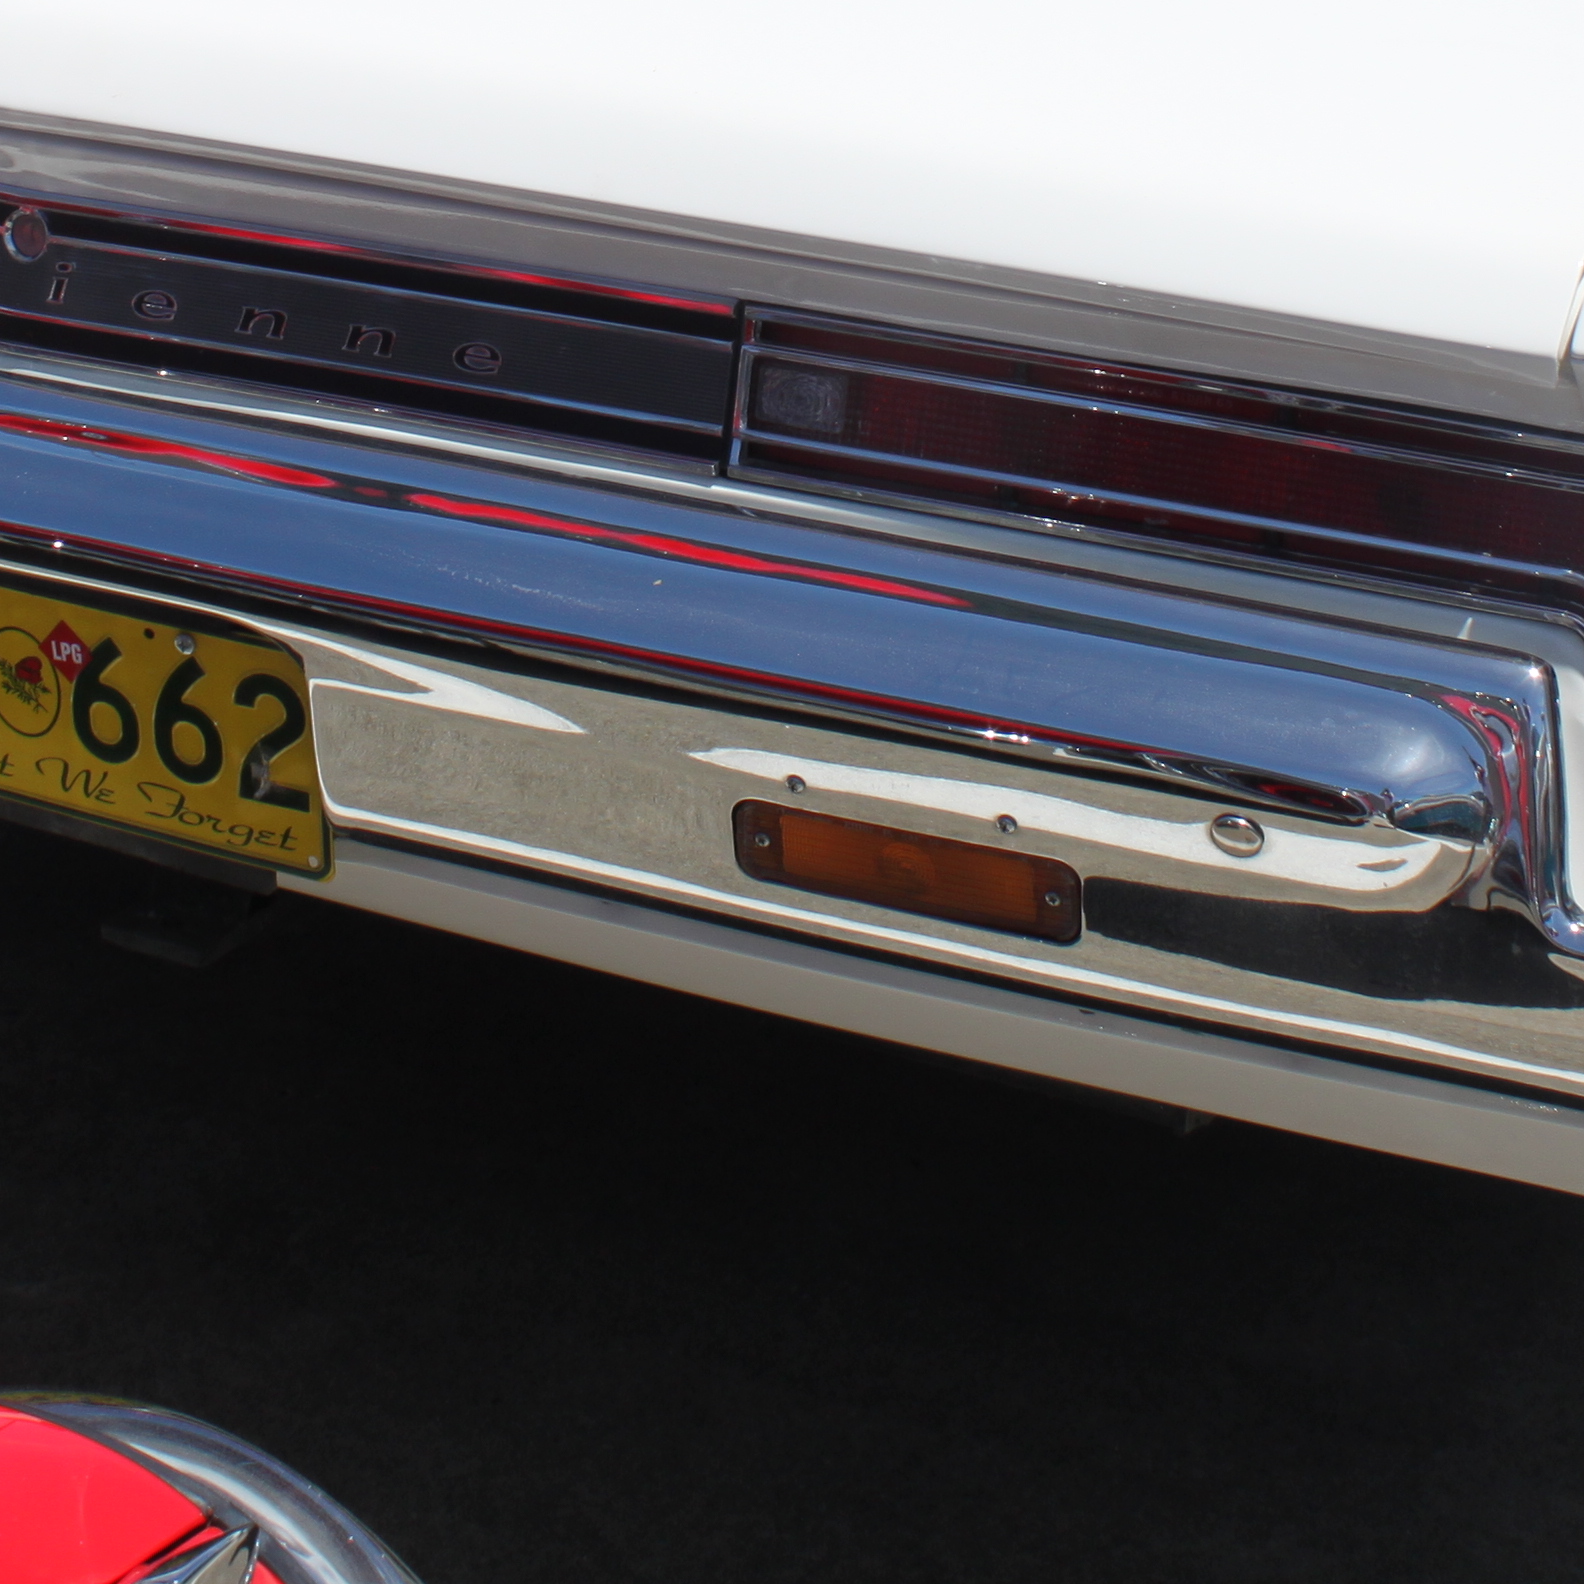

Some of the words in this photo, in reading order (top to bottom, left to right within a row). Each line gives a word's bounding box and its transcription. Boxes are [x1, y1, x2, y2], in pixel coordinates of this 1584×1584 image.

[51, 640, 83, 664] LPG
[71, 636, 311, 814] 662
[35, 756, 117, 805] We
[137, 780, 299, 852] Forget
